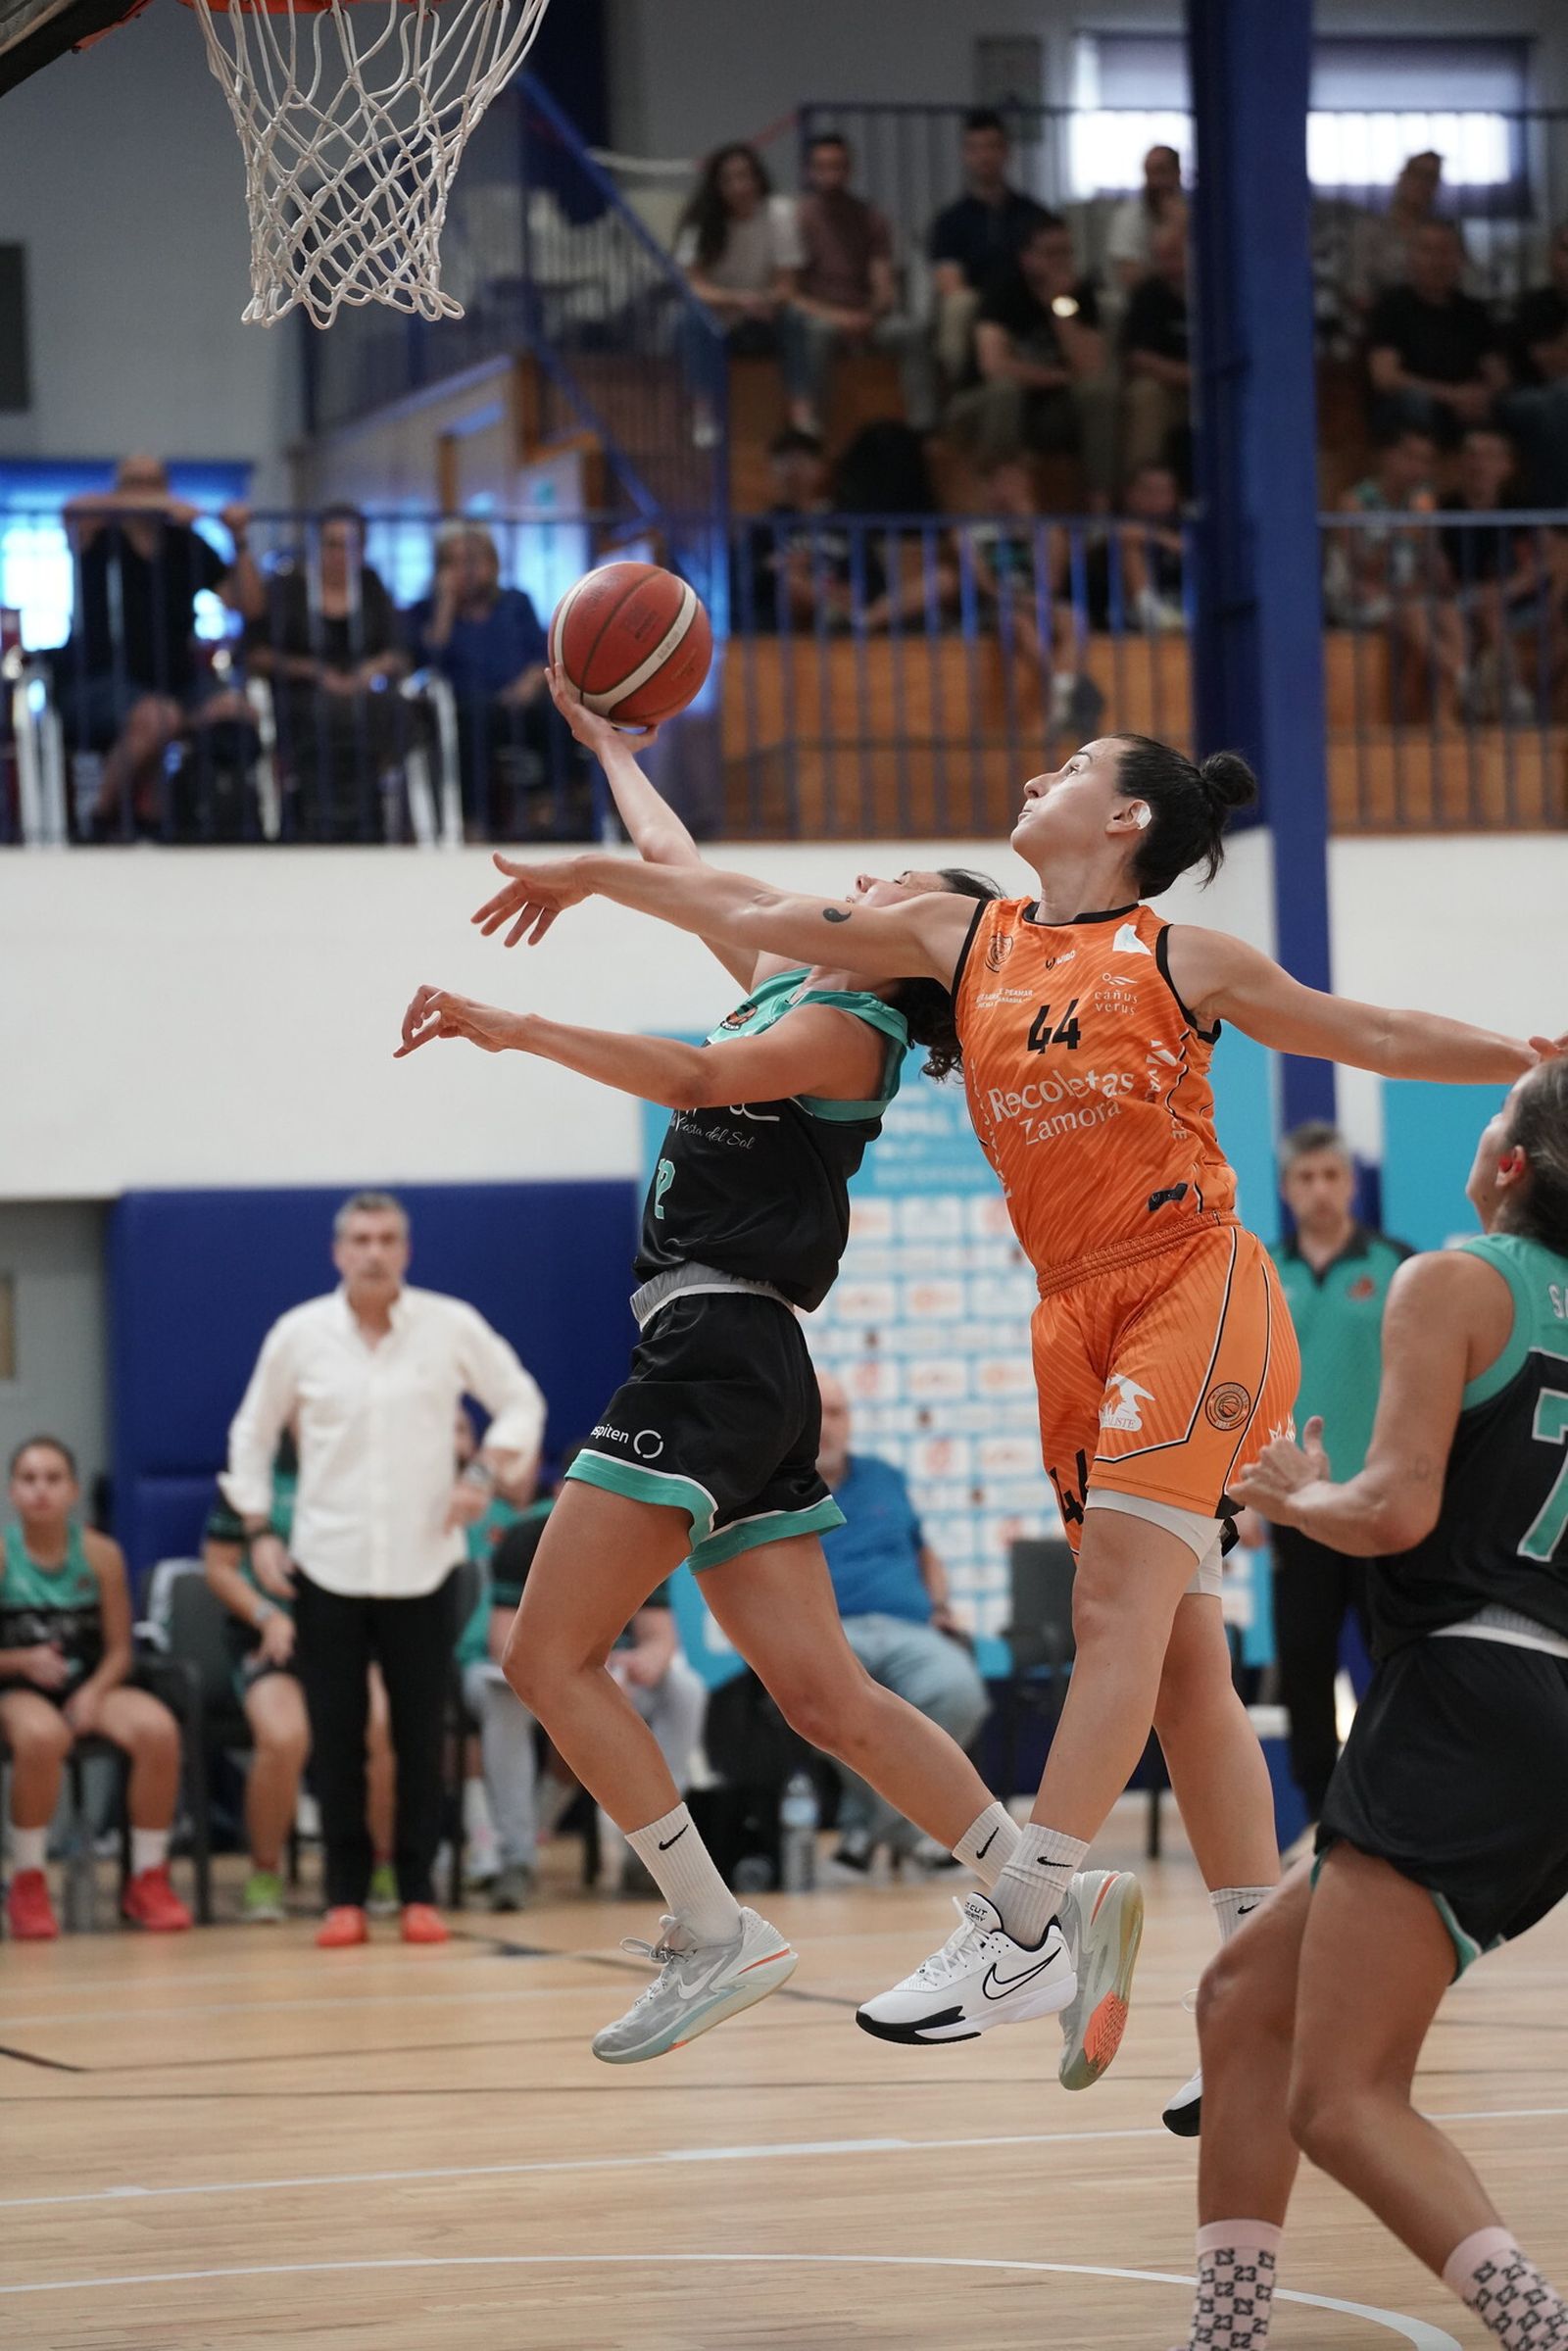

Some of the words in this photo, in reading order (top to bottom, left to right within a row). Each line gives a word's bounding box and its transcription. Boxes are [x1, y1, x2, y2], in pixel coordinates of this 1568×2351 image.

[1027, 999, 1081, 1054] 44
[705, 1126, 728, 1143] del
[726, 1131, 756, 1150] Sol
[1019, 1100, 1121, 1146] Zamora
